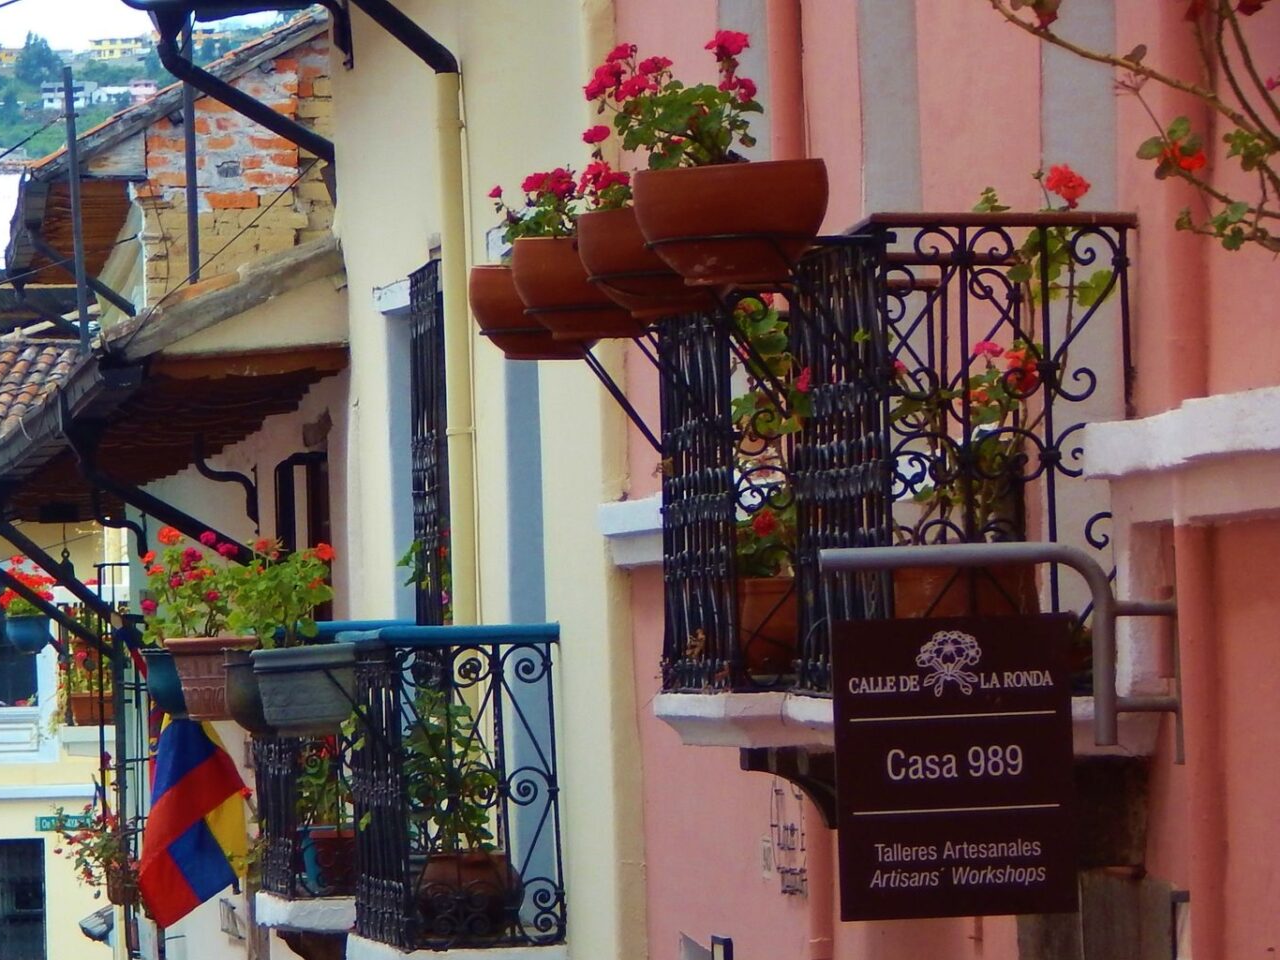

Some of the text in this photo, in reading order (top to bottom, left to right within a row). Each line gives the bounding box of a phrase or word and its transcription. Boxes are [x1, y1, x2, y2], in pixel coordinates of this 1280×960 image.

[848, 670, 1054, 694] CALLE DE LA RONDA
[886, 744, 1023, 781] Casa 989
[874, 838, 1041, 862] Talleres Artesanales
[951, 864, 1046, 886] Workshops
